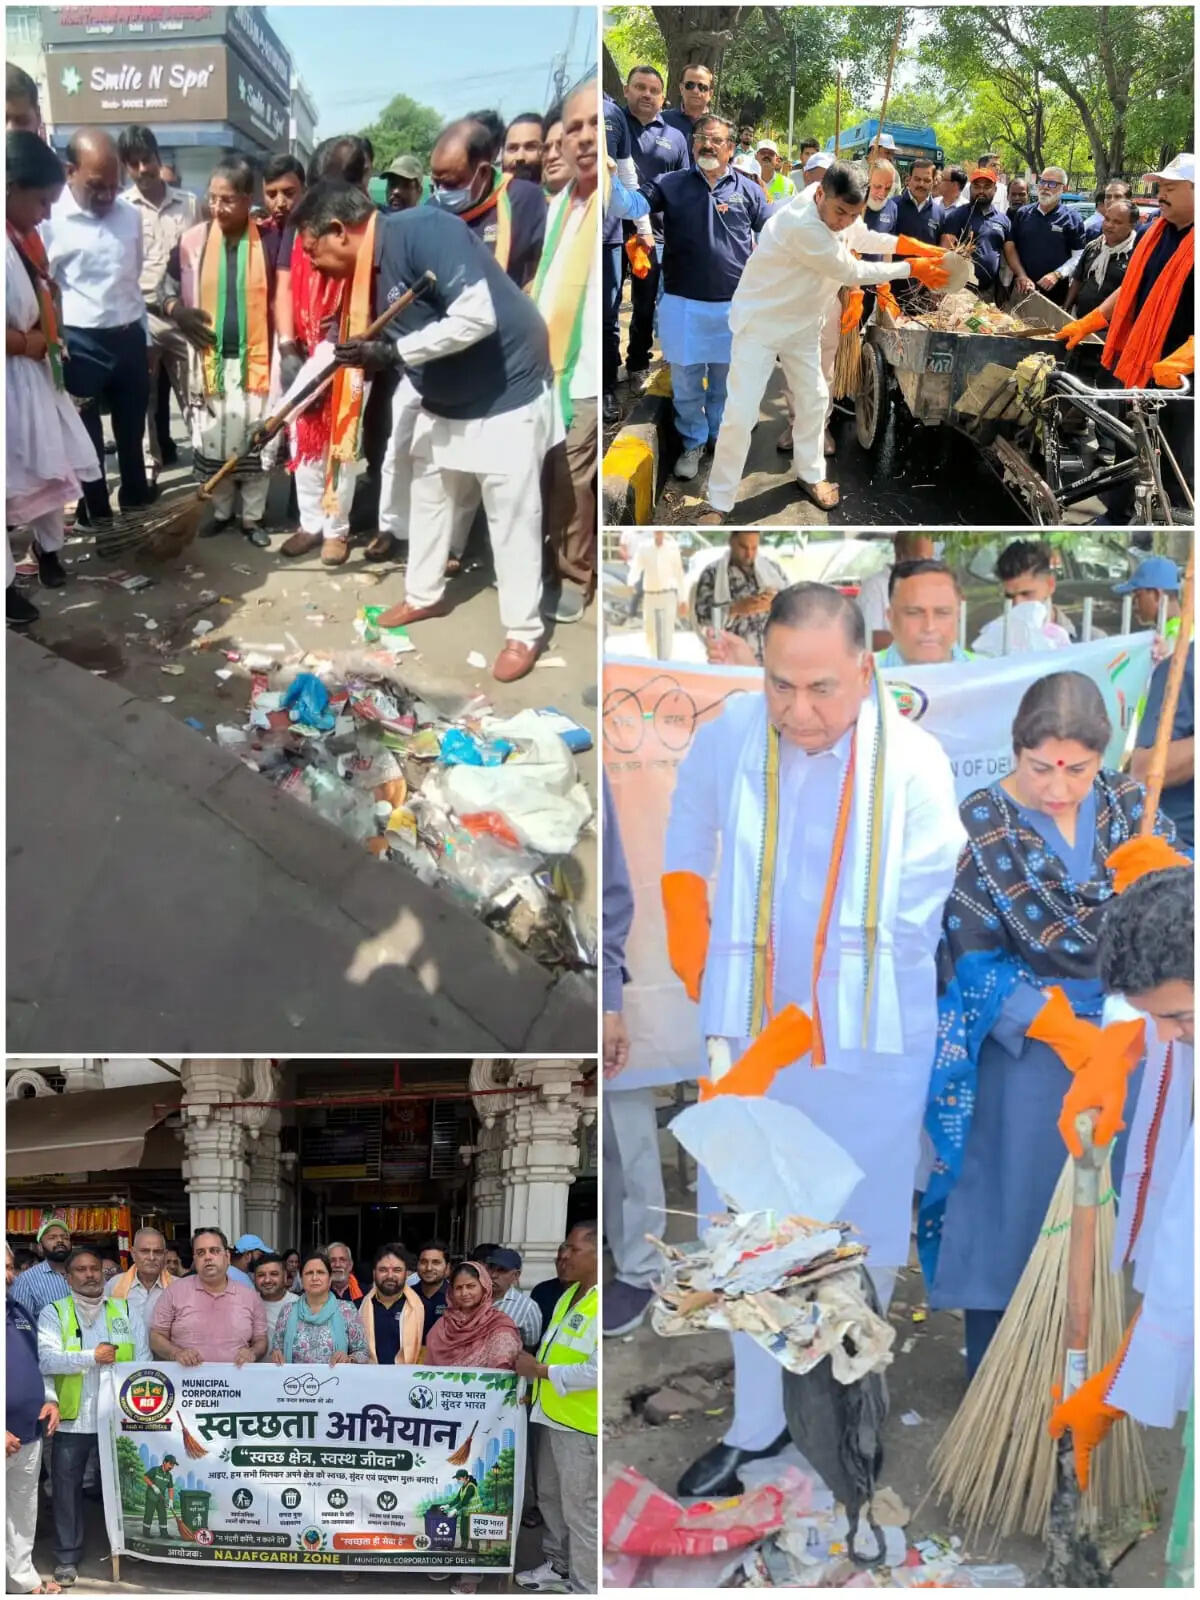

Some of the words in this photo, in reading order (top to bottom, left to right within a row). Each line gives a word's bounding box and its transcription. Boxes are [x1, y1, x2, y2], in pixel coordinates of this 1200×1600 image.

[90, 63, 142, 92] Smile
[149, 64, 164, 90] N
[963, 759, 983, 777] OF
[181, 1379, 229, 1388] MUNICIPAL
[181, 1389, 241, 1398] CORPORATION
[440, 1390, 463, 1399] स्वच्छ
[465, 1391, 487, 1400] भारत
[181, 1400, 193, 1408] OF
[195, 1400, 219, 1408] DELHI
[440, 1399, 462, 1411] सुंदर
[464, 1401, 487, 1410] भारत
[195, 1411, 318, 1441] स्वच्छता
[326, 1404, 462, 1450] अभियान
[240, 1448, 285, 1464] “स्वच्छ
[288, 1448, 316, 1466] क्षेत्र,
[320, 1452, 357, 1466] स्वस्थ
[360, 1450, 405, 1468] जीवन”
[243, 1469, 257, 1479] सभी
[260, 1469, 283, 1479] मिलकर
[285, 1470, 301, 1479] अपने
[303, 1469, 314, 1479] क्षेत्र
[315, 1470, 325, 1479] को
[349, 1472, 364, 1483] सुंदर
[489, 1519, 504, 1527] भारत
[488, 1528, 503, 1536] भारत
[214, 1550, 298, 1563] NAJAFGARH
[303, 1553, 340, 1564] ZONE
[354, 1556, 392, 1564] MUNICIPAL
[394, 1556, 442, 1564] CORPORATION
[445, 1556, 454, 1564] OF
[456, 1556, 475, 1564] DELHI
